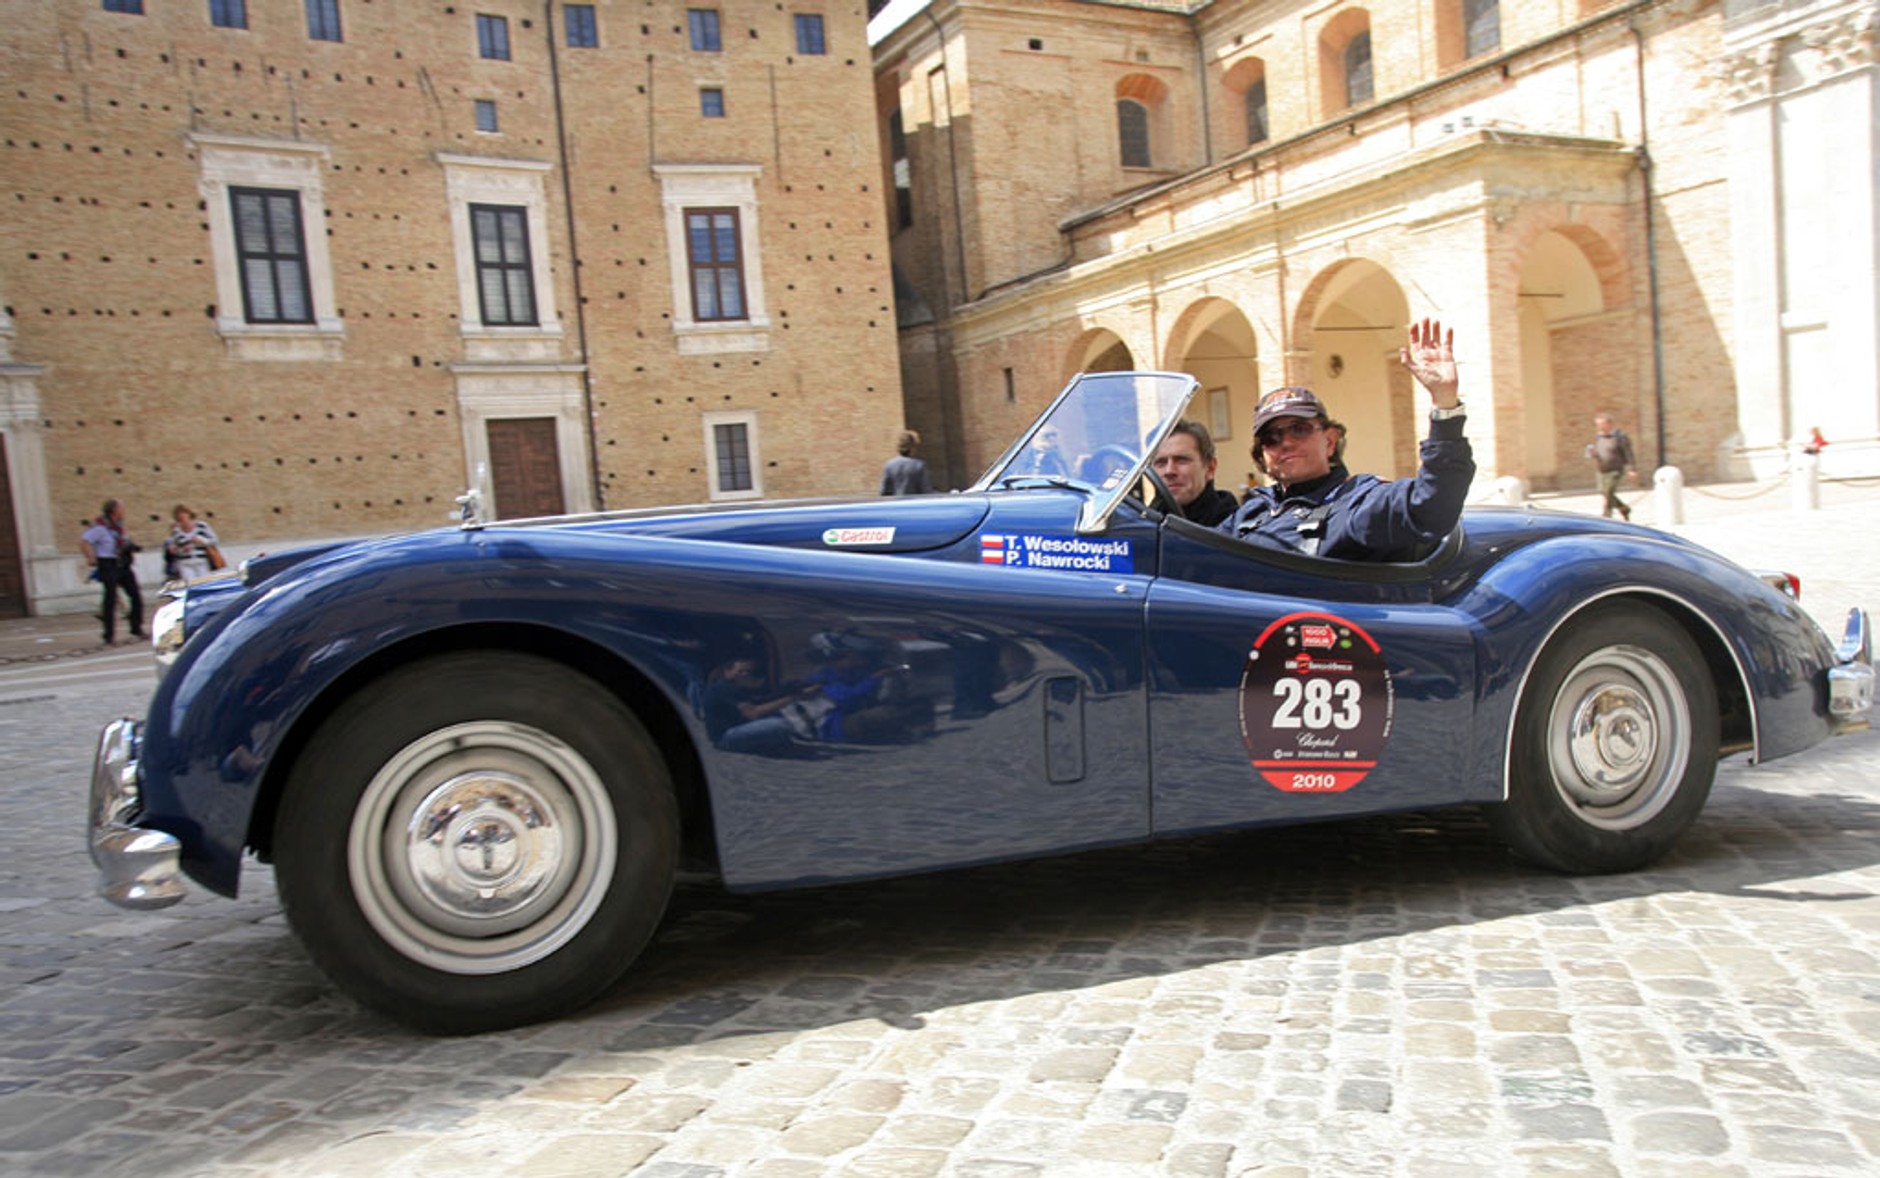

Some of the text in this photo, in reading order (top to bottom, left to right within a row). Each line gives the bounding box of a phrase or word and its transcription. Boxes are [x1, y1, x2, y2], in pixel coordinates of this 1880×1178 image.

[1004, 535, 1021, 551] T.
[1006, 550, 1111, 571] P. Nawrocki
[1272, 677, 1362, 730] 283
[1292, 774, 1335, 789] 2010
